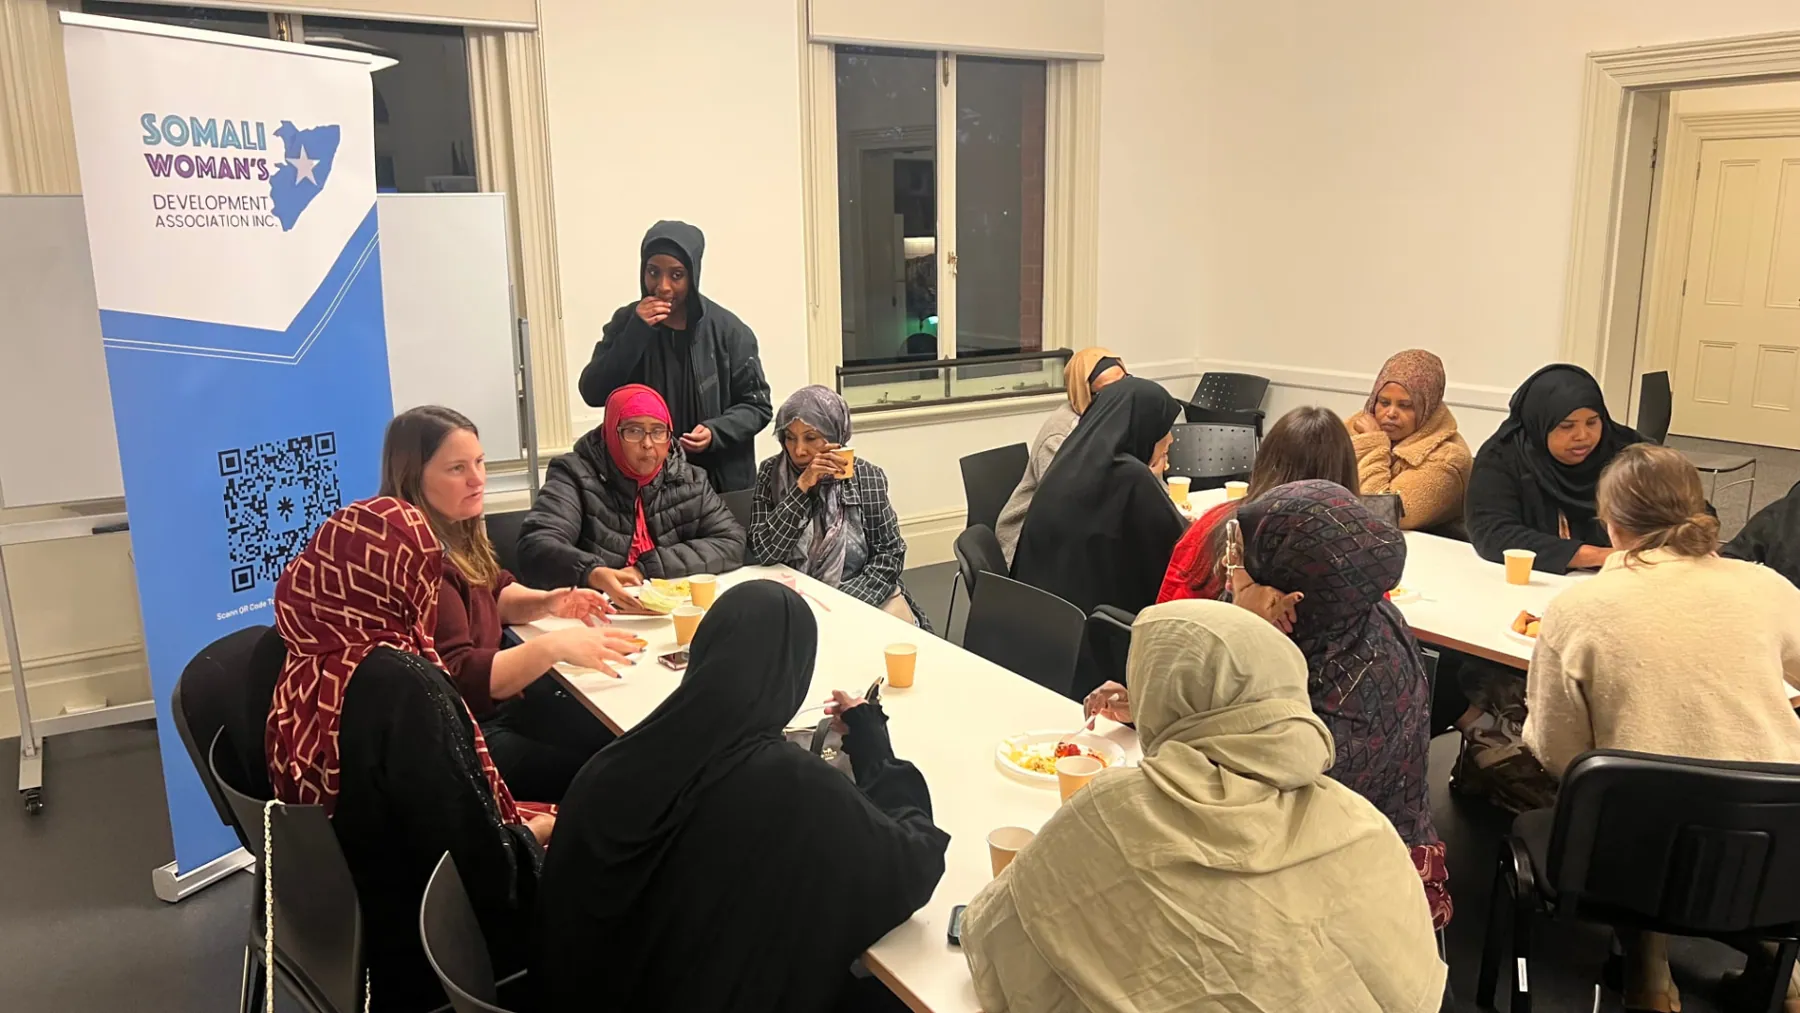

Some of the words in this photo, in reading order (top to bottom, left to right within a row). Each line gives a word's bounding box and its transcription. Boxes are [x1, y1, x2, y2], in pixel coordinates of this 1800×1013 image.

[140, 113, 267, 151] SOMALI
[144, 153, 270, 181] WOMAN'S
[153, 194, 268, 211] DEVELOPMENT
[155, 214, 250, 228] ASSOCIATION
[252, 215, 279, 228] INC.
[216, 609, 238, 620] Scann
[239, 605, 249, 614] QR
[249, 601, 267, 611] Code
